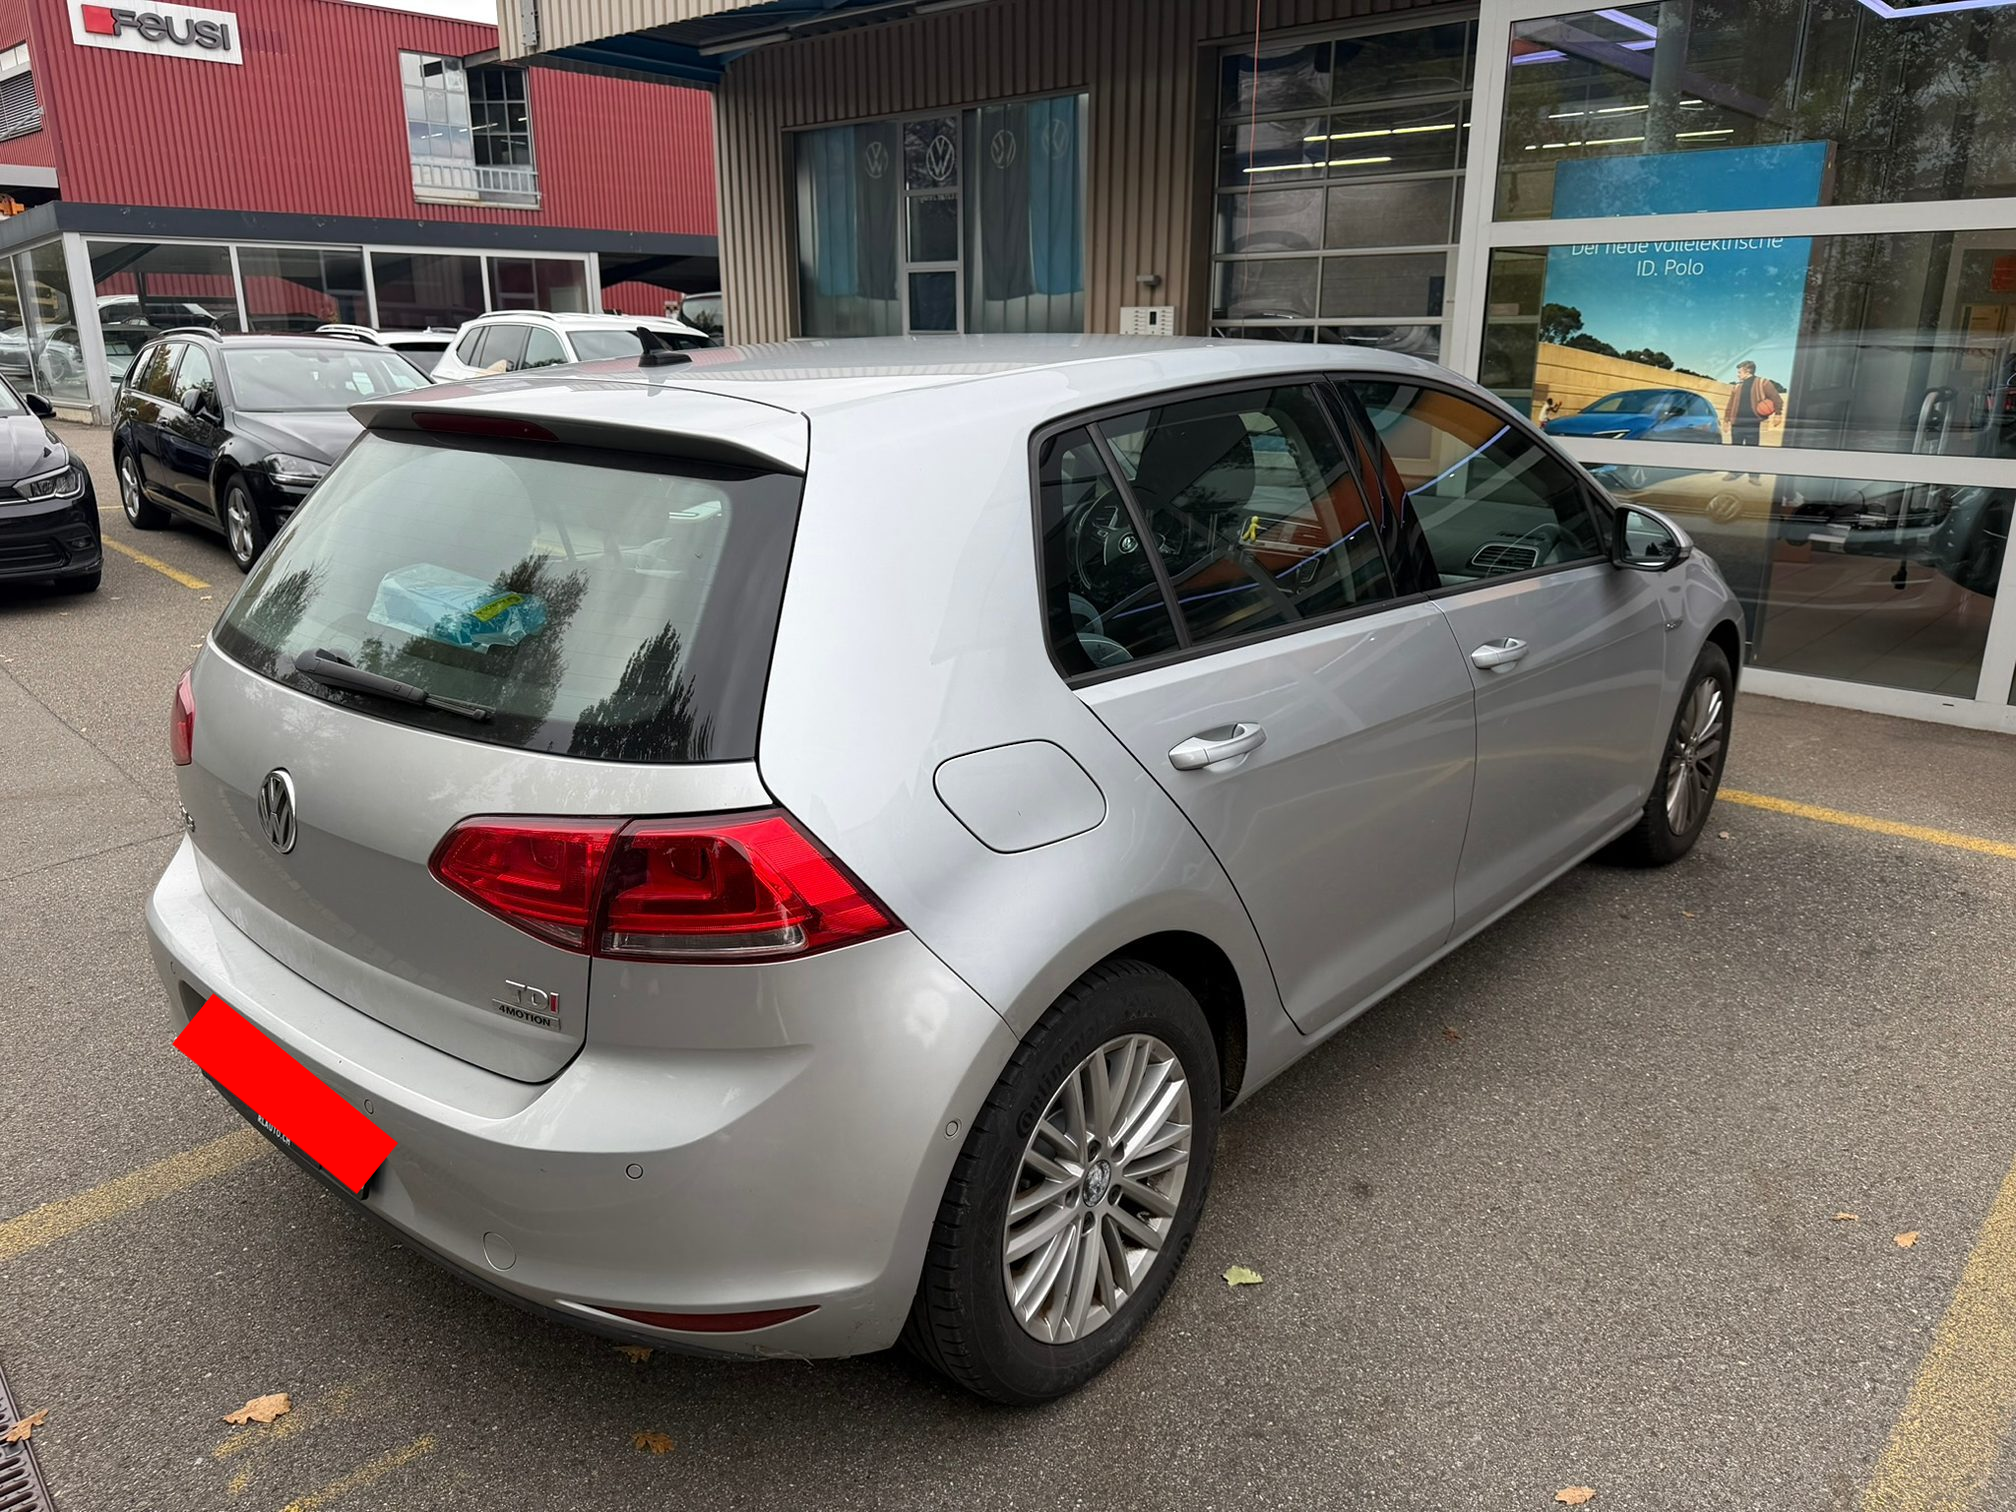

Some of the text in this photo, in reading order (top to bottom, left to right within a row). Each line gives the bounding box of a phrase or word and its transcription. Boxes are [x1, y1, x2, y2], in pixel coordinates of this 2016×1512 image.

[1636, 258, 1704, 277] ID. Polo
[505, 979, 560, 1015] TDI
[498, 1004, 551, 1027] 4MOTION
